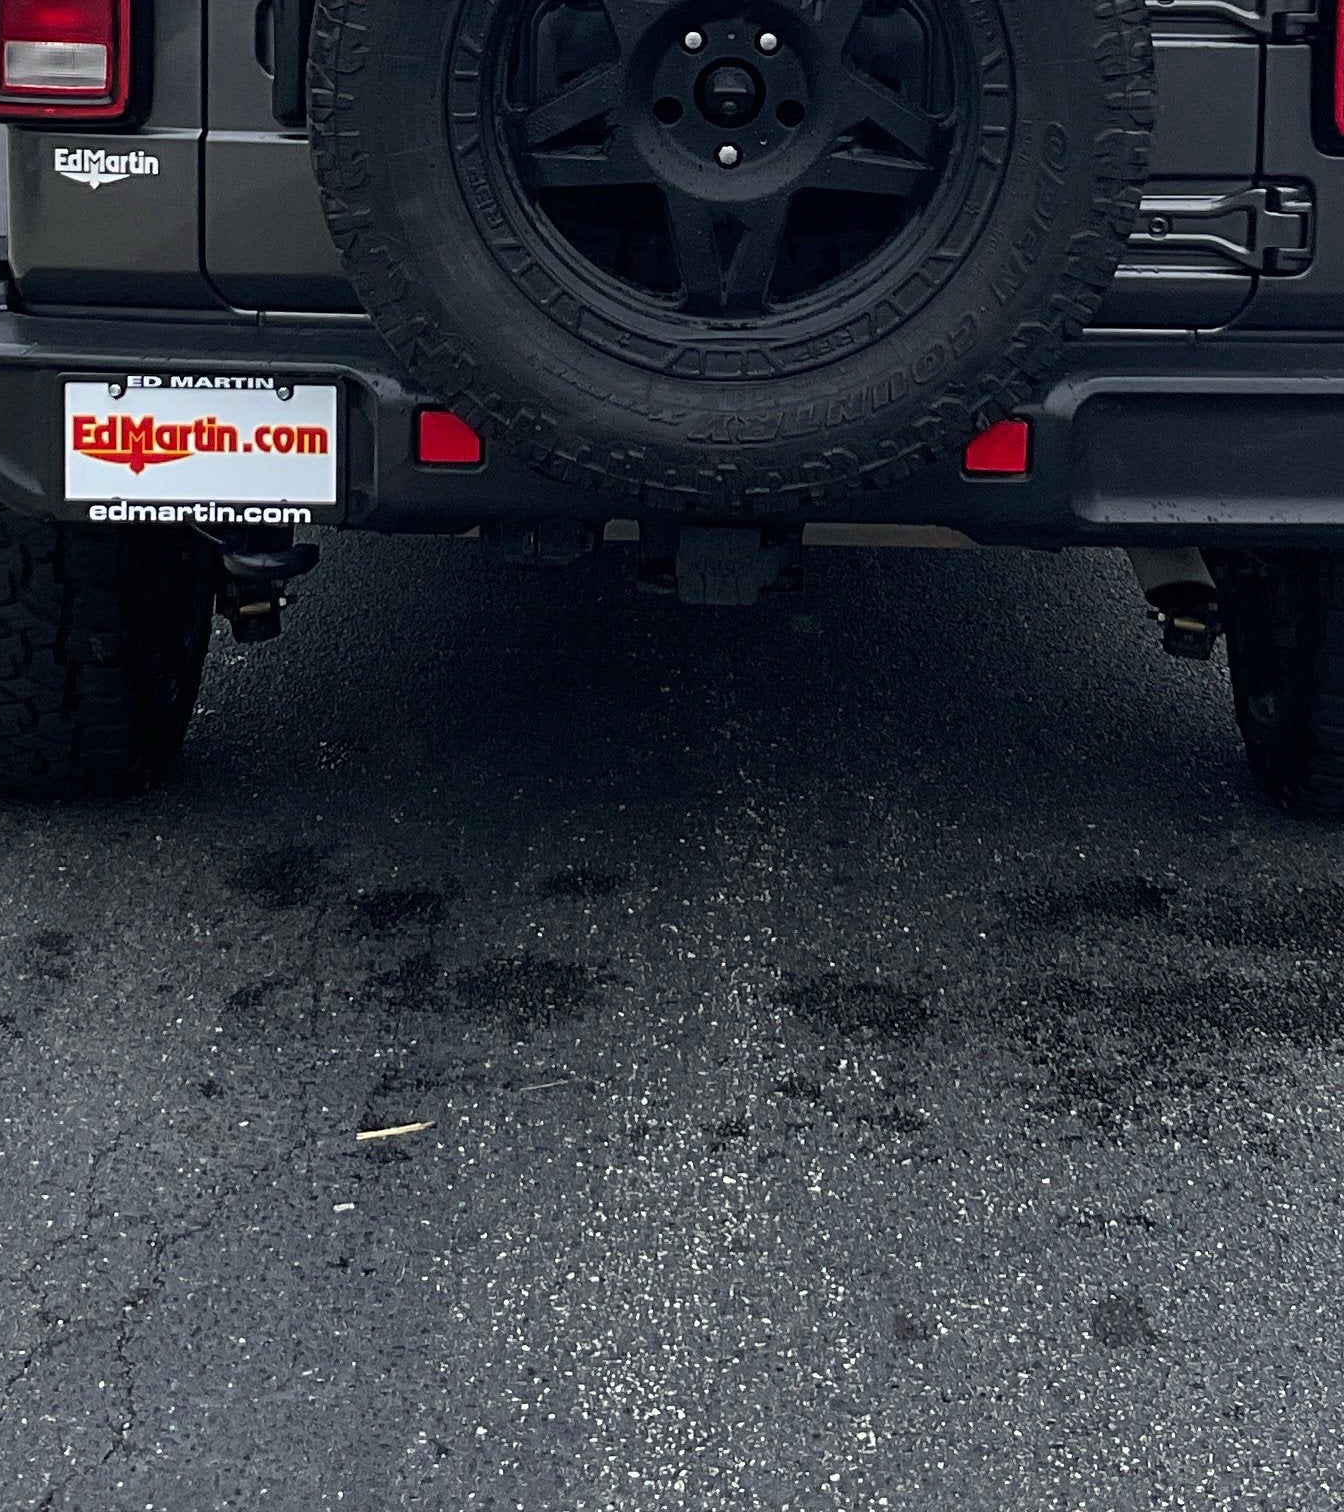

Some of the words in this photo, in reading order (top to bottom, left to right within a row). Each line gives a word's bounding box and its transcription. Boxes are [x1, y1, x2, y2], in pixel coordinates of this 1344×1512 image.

[54, 147, 160, 181] EdMartin
[126, 374, 165, 390] ED
[170, 374, 275, 390] MARTIN
[71, 413, 329, 460] EdMartin.com
[88, 500, 313, 525] edmartin.com
